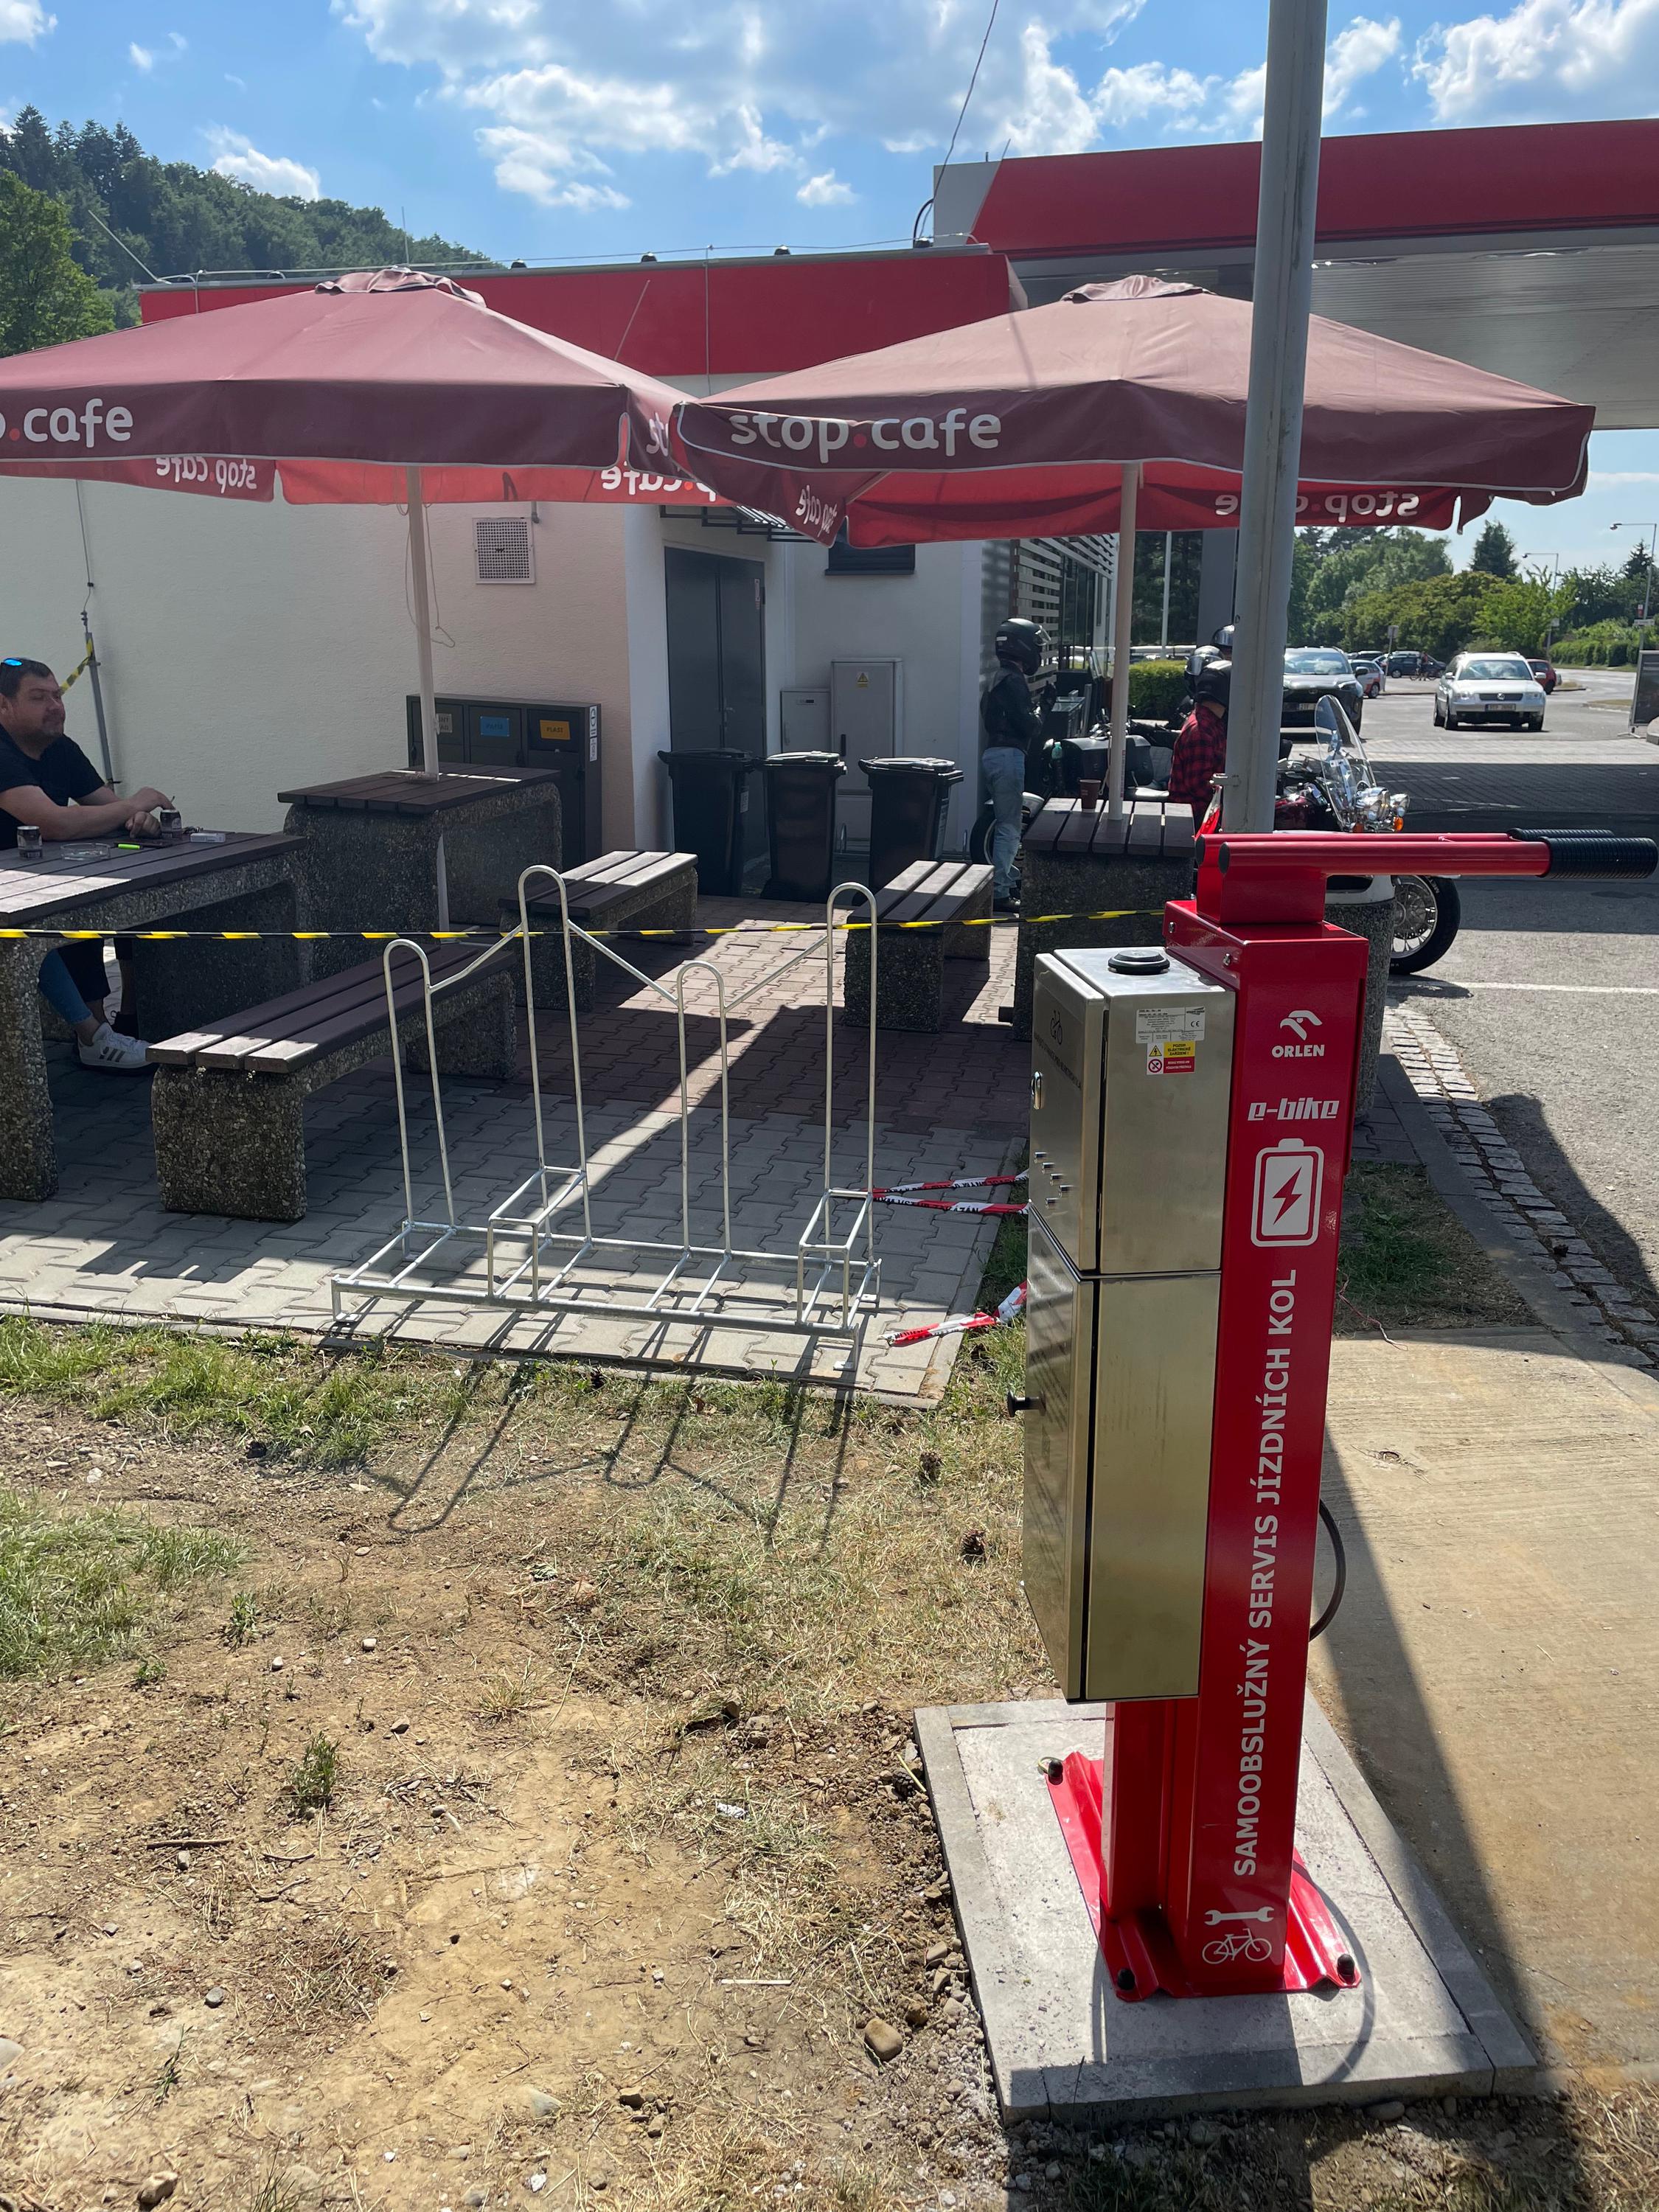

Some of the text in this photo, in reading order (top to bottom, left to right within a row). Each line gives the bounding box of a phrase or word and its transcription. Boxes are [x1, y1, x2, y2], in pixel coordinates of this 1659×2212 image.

[0, 398, 133, 448] .cafe
[730, 408, 1001, 463] stop.cafe
[1272, 1044, 1325, 1057] ORLEN
[1248, 1097, 1340, 1121] e-bike
[1234, 1269, 1297, 1877] SAMOOBSLUŽNÝ SERVIS JÍZDNÍCH KOL
